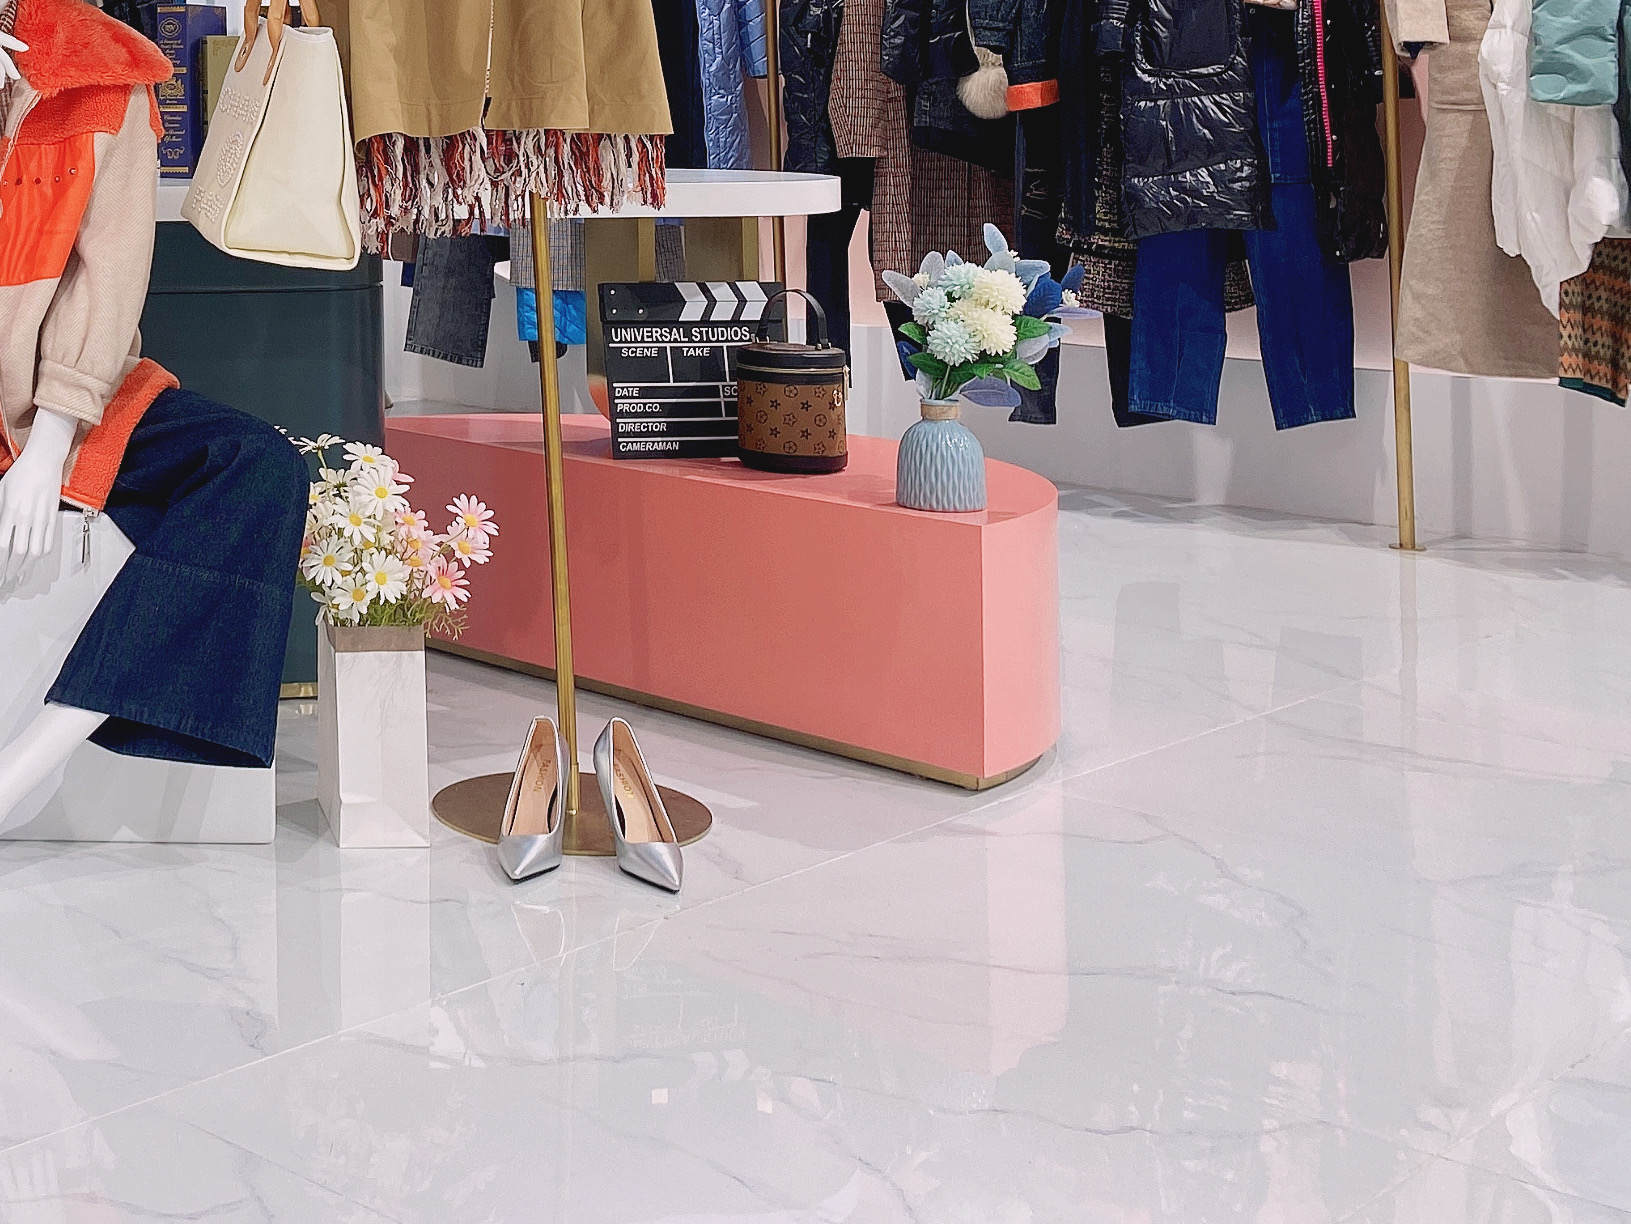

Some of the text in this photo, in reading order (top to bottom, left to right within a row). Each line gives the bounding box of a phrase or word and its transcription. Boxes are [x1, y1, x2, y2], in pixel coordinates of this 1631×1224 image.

[611, 326, 750, 342] UNIVERSAL STUDIOS
[621, 347, 659, 357] SCENE
[682, 347, 711, 357] TAKE
[615, 387, 640, 397] DATE
[616, 403, 662, 413] PROD.CO.
[618, 422, 667, 433] DIRECTOR
[619, 441, 680, 452] CAMERAMAN
[533, 759, 551, 793] FASHION
